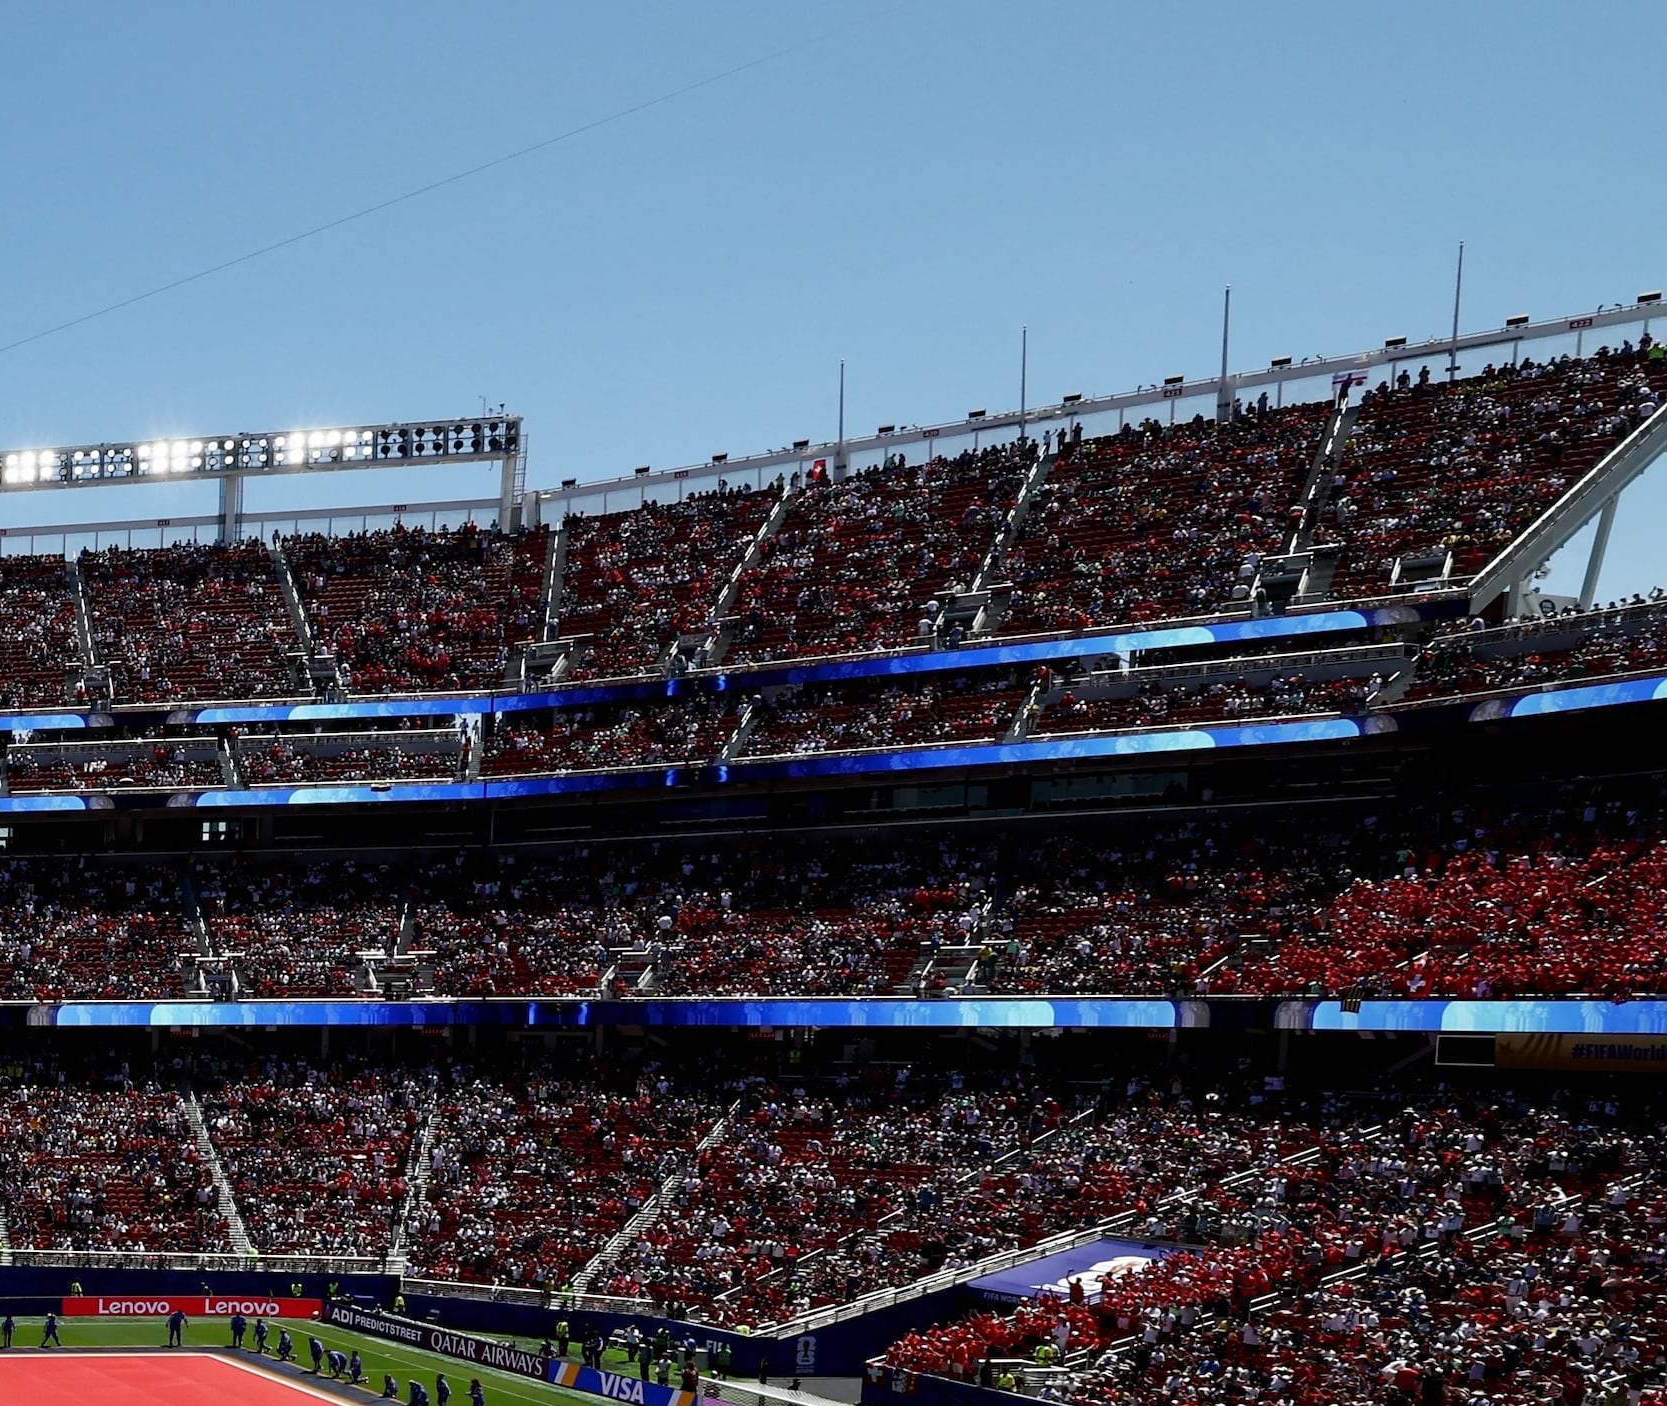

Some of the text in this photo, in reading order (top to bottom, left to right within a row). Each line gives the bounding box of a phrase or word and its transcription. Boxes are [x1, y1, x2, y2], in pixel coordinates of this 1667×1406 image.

[98, 1297, 170, 1315] Lenovo
[204, 1297, 280, 1316] Lenovo
[354, 1314, 423, 1342] PREDICTSTREET
[430, 1331, 543, 1376] QATAR AIRWAYS
[597, 1370, 645, 1405] VISA
